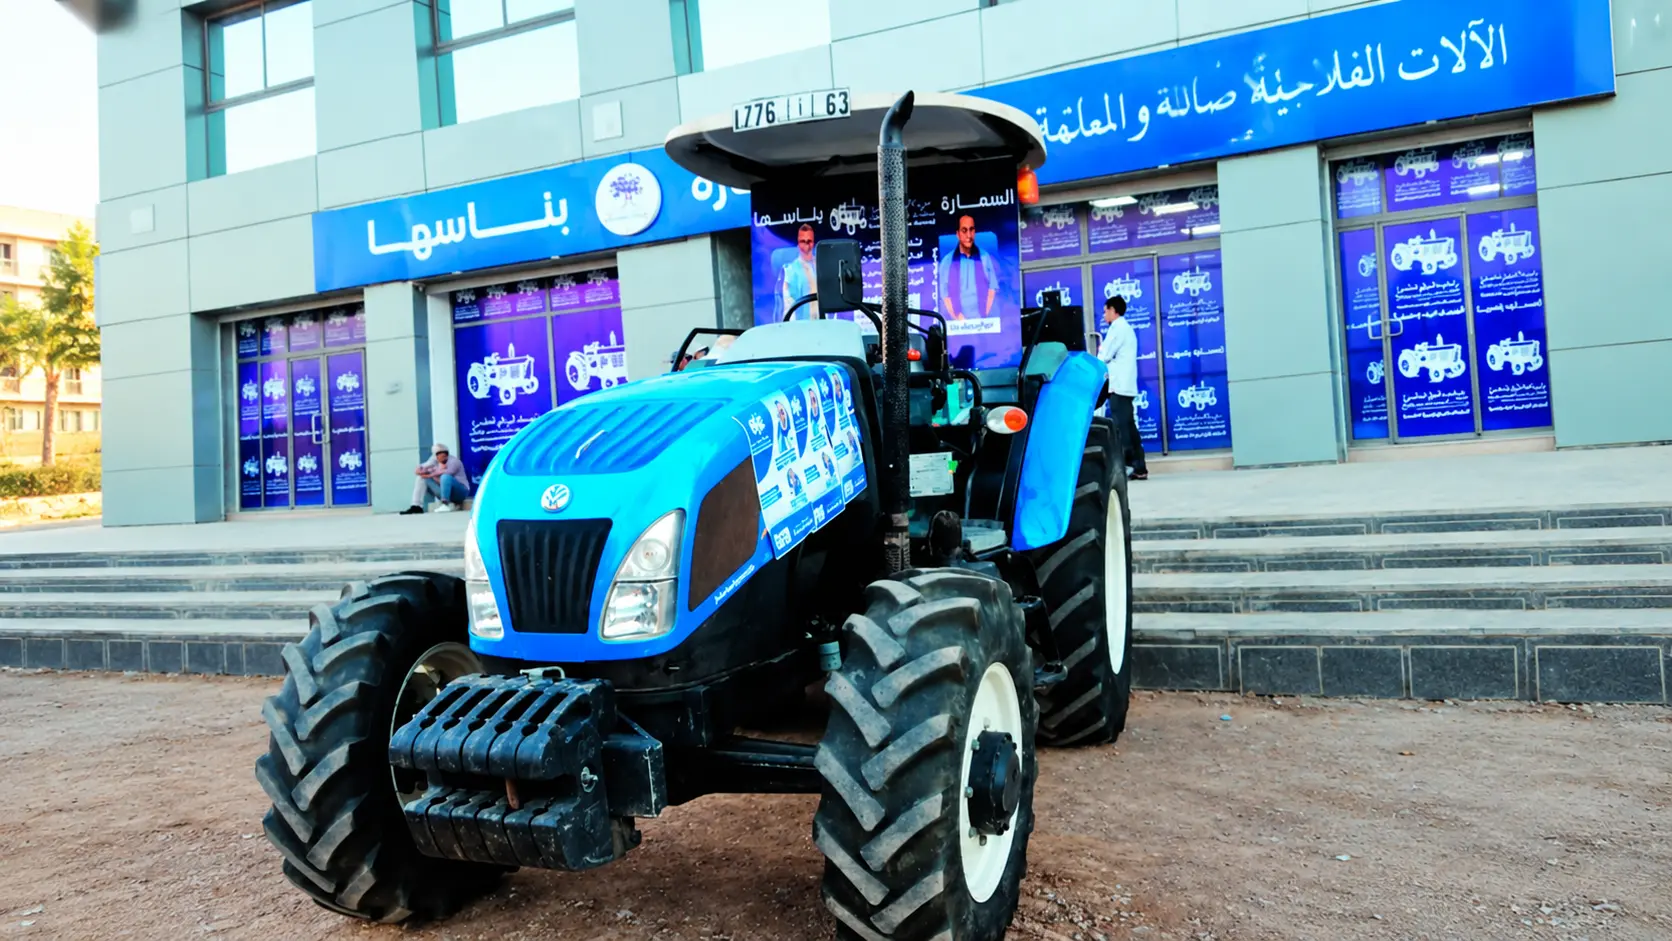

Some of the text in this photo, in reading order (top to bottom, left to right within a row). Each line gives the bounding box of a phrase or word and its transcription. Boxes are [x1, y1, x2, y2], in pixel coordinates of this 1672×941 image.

[1398, 18, 1507, 81] الآلات
[826, 91, 849, 116] 63
[941, 188, 1014, 215] السمارة
[367, 191, 570, 261] بناسها
